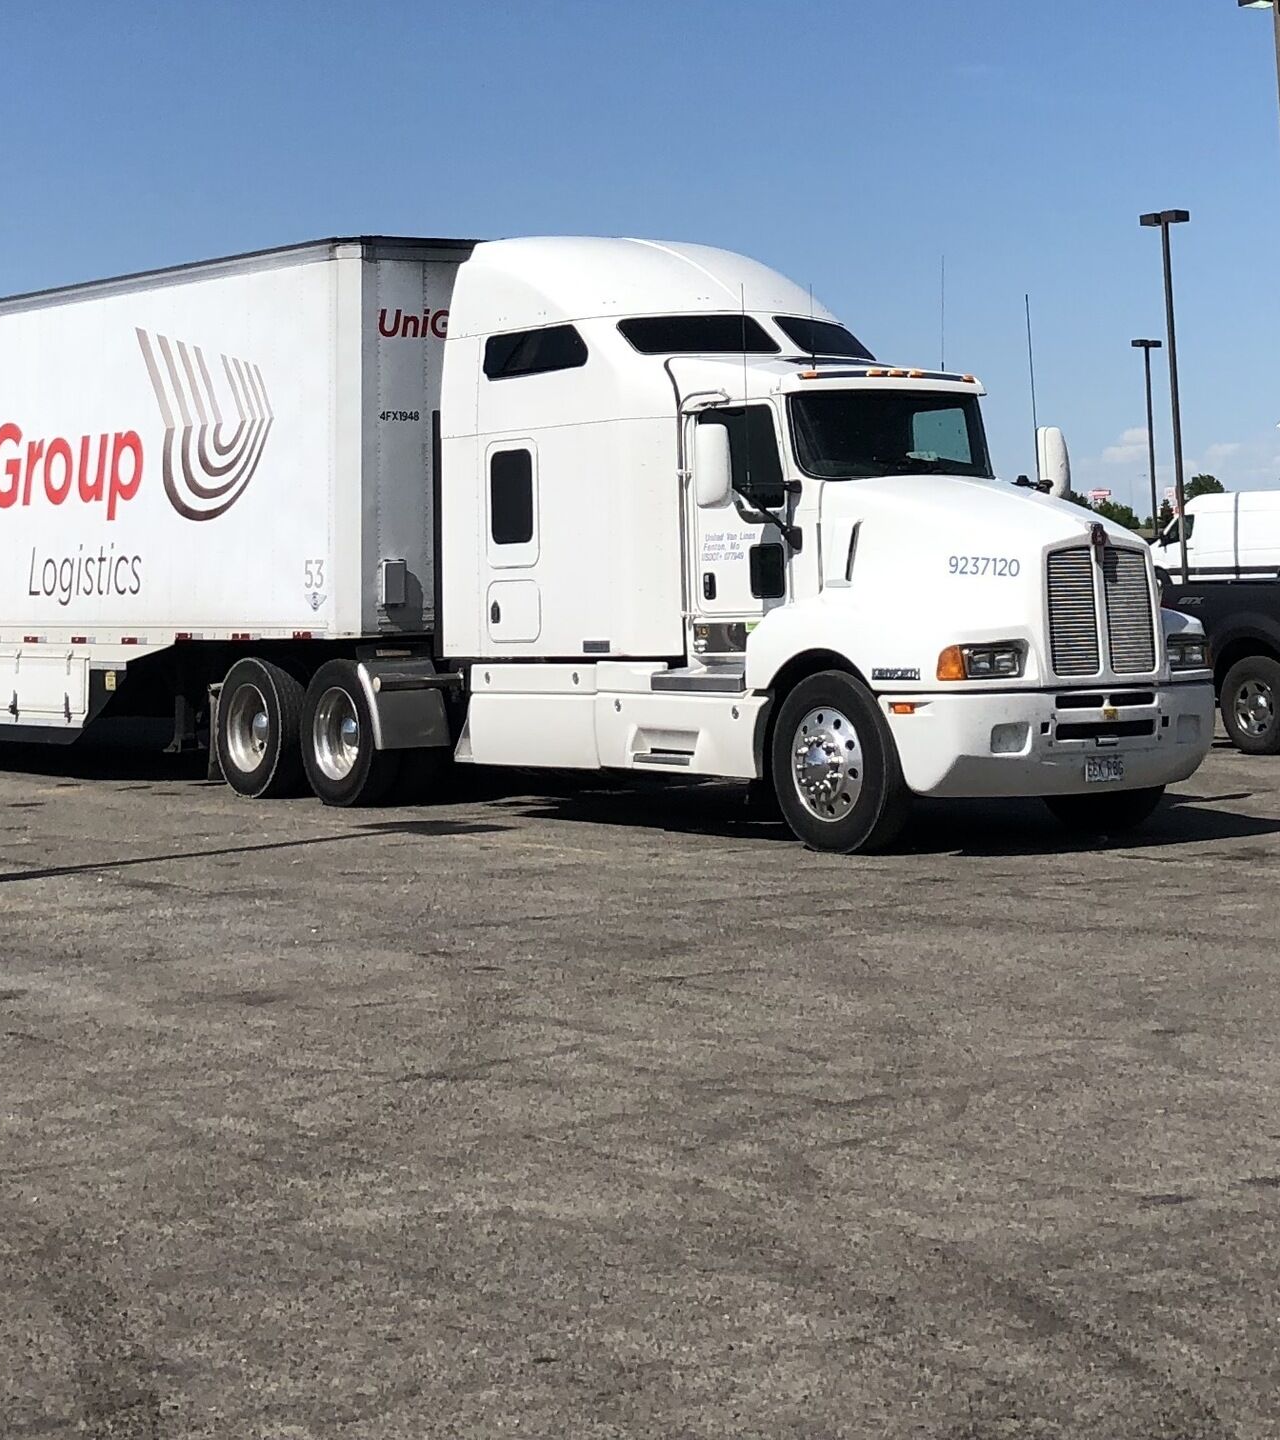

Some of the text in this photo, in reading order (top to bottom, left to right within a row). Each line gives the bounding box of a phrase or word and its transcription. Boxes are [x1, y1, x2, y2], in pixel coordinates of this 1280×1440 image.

[379, 410, 420, 422] 4FX1948
[739, 531, 756, 541] Lines
[28, 542, 143, 607] Logistics
[304, 559, 325, 589] 53
[948, 555, 1021, 578] 9237120
